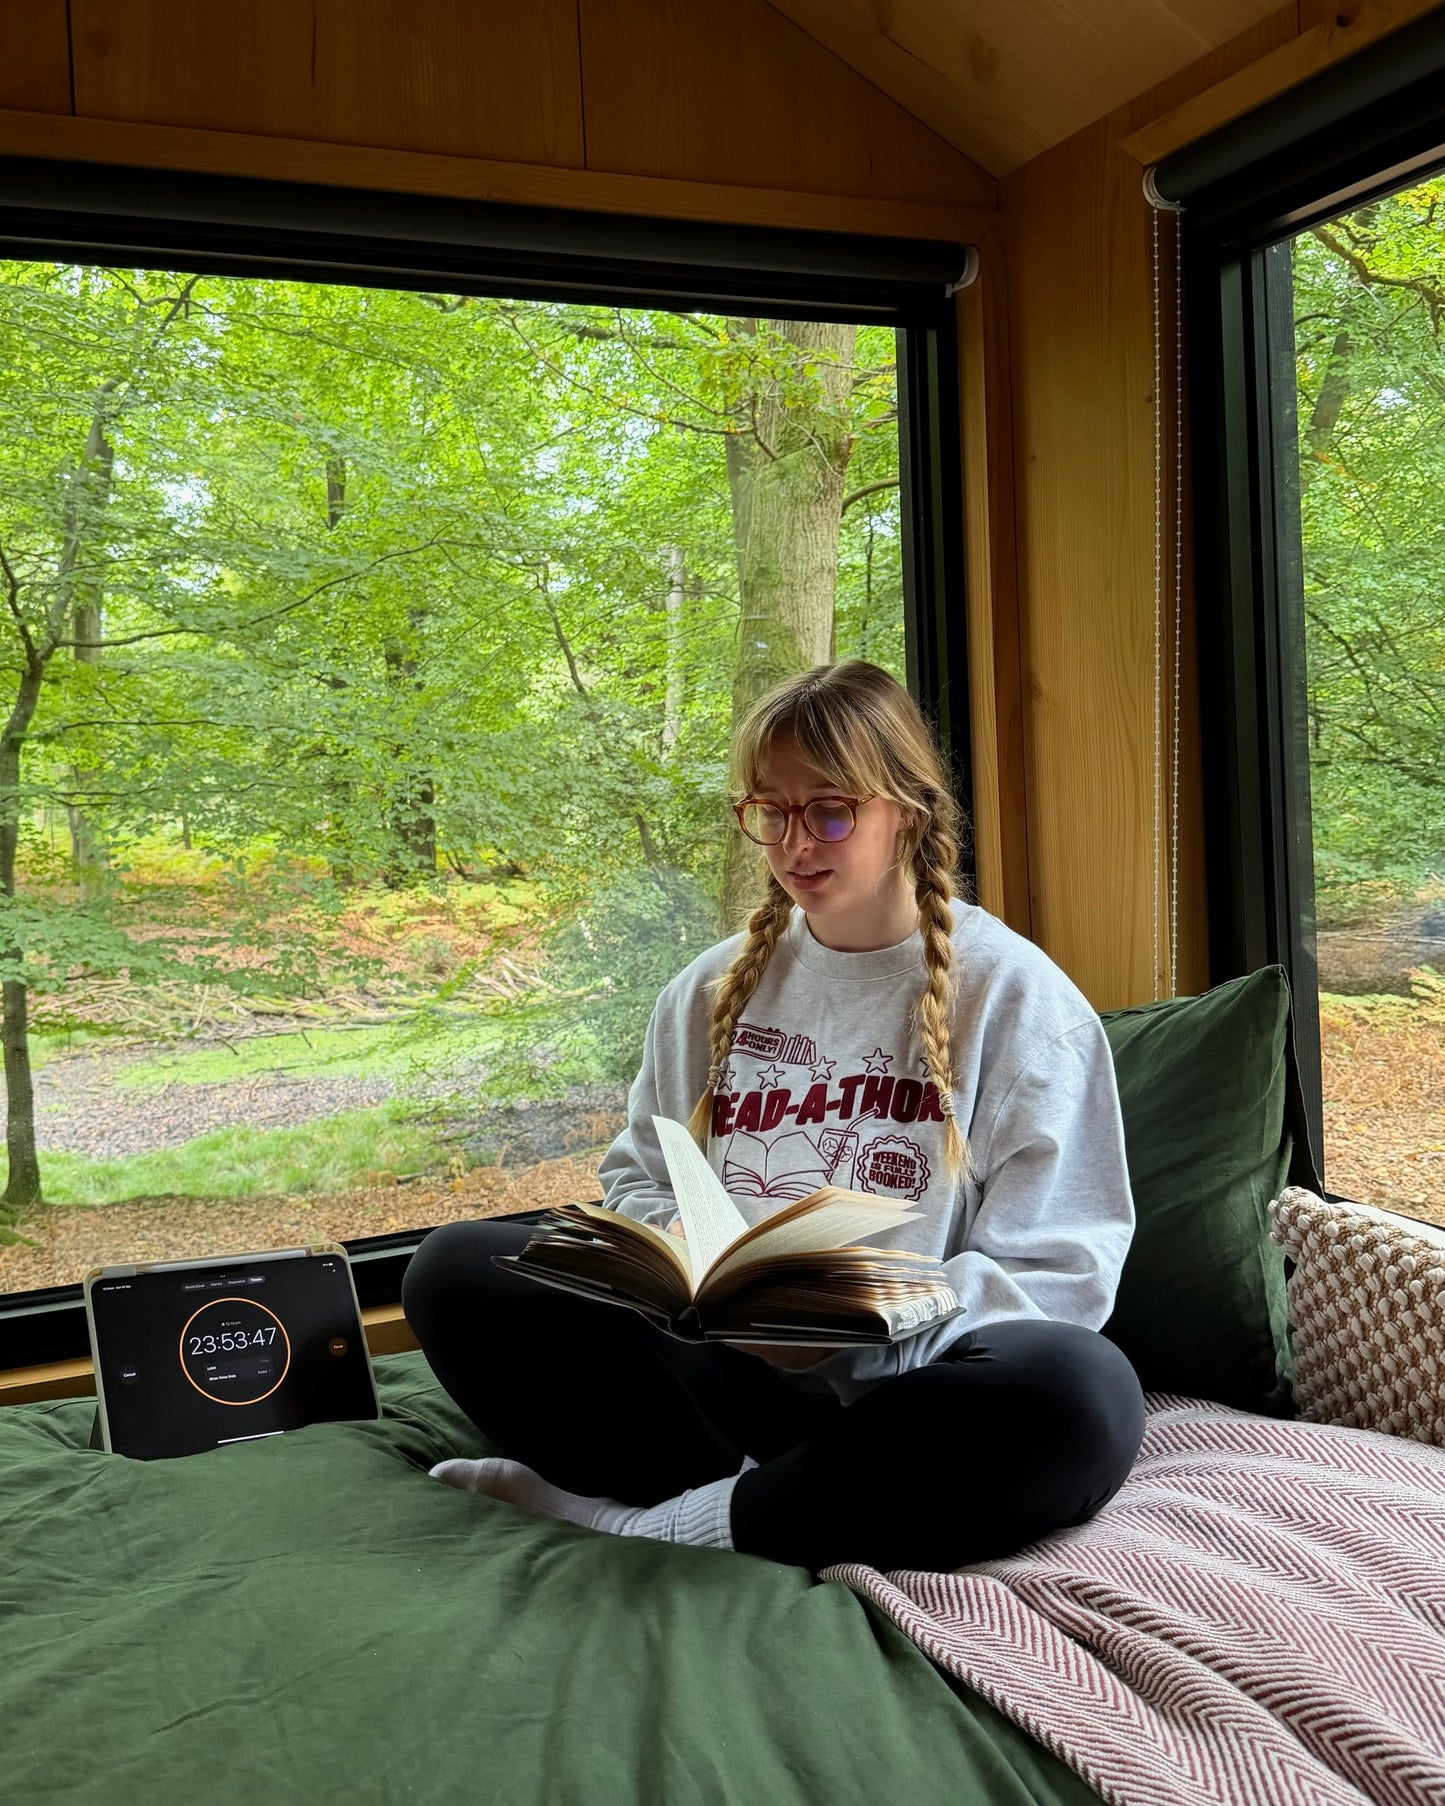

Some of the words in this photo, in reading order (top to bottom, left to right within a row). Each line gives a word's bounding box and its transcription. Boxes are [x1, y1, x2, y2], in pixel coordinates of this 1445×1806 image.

[747, 1031, 780, 1047] HOURS
[748, 1040, 778, 1054] ONLY!
[872, 1151, 917, 1170] WEEKEND
[870, 1162, 882, 1171] IS
[883, 1164, 917, 1177] FULLY
[868, 1168, 916, 1190] BOOKED!
[189, 1327, 277, 1356] 23:53:47
